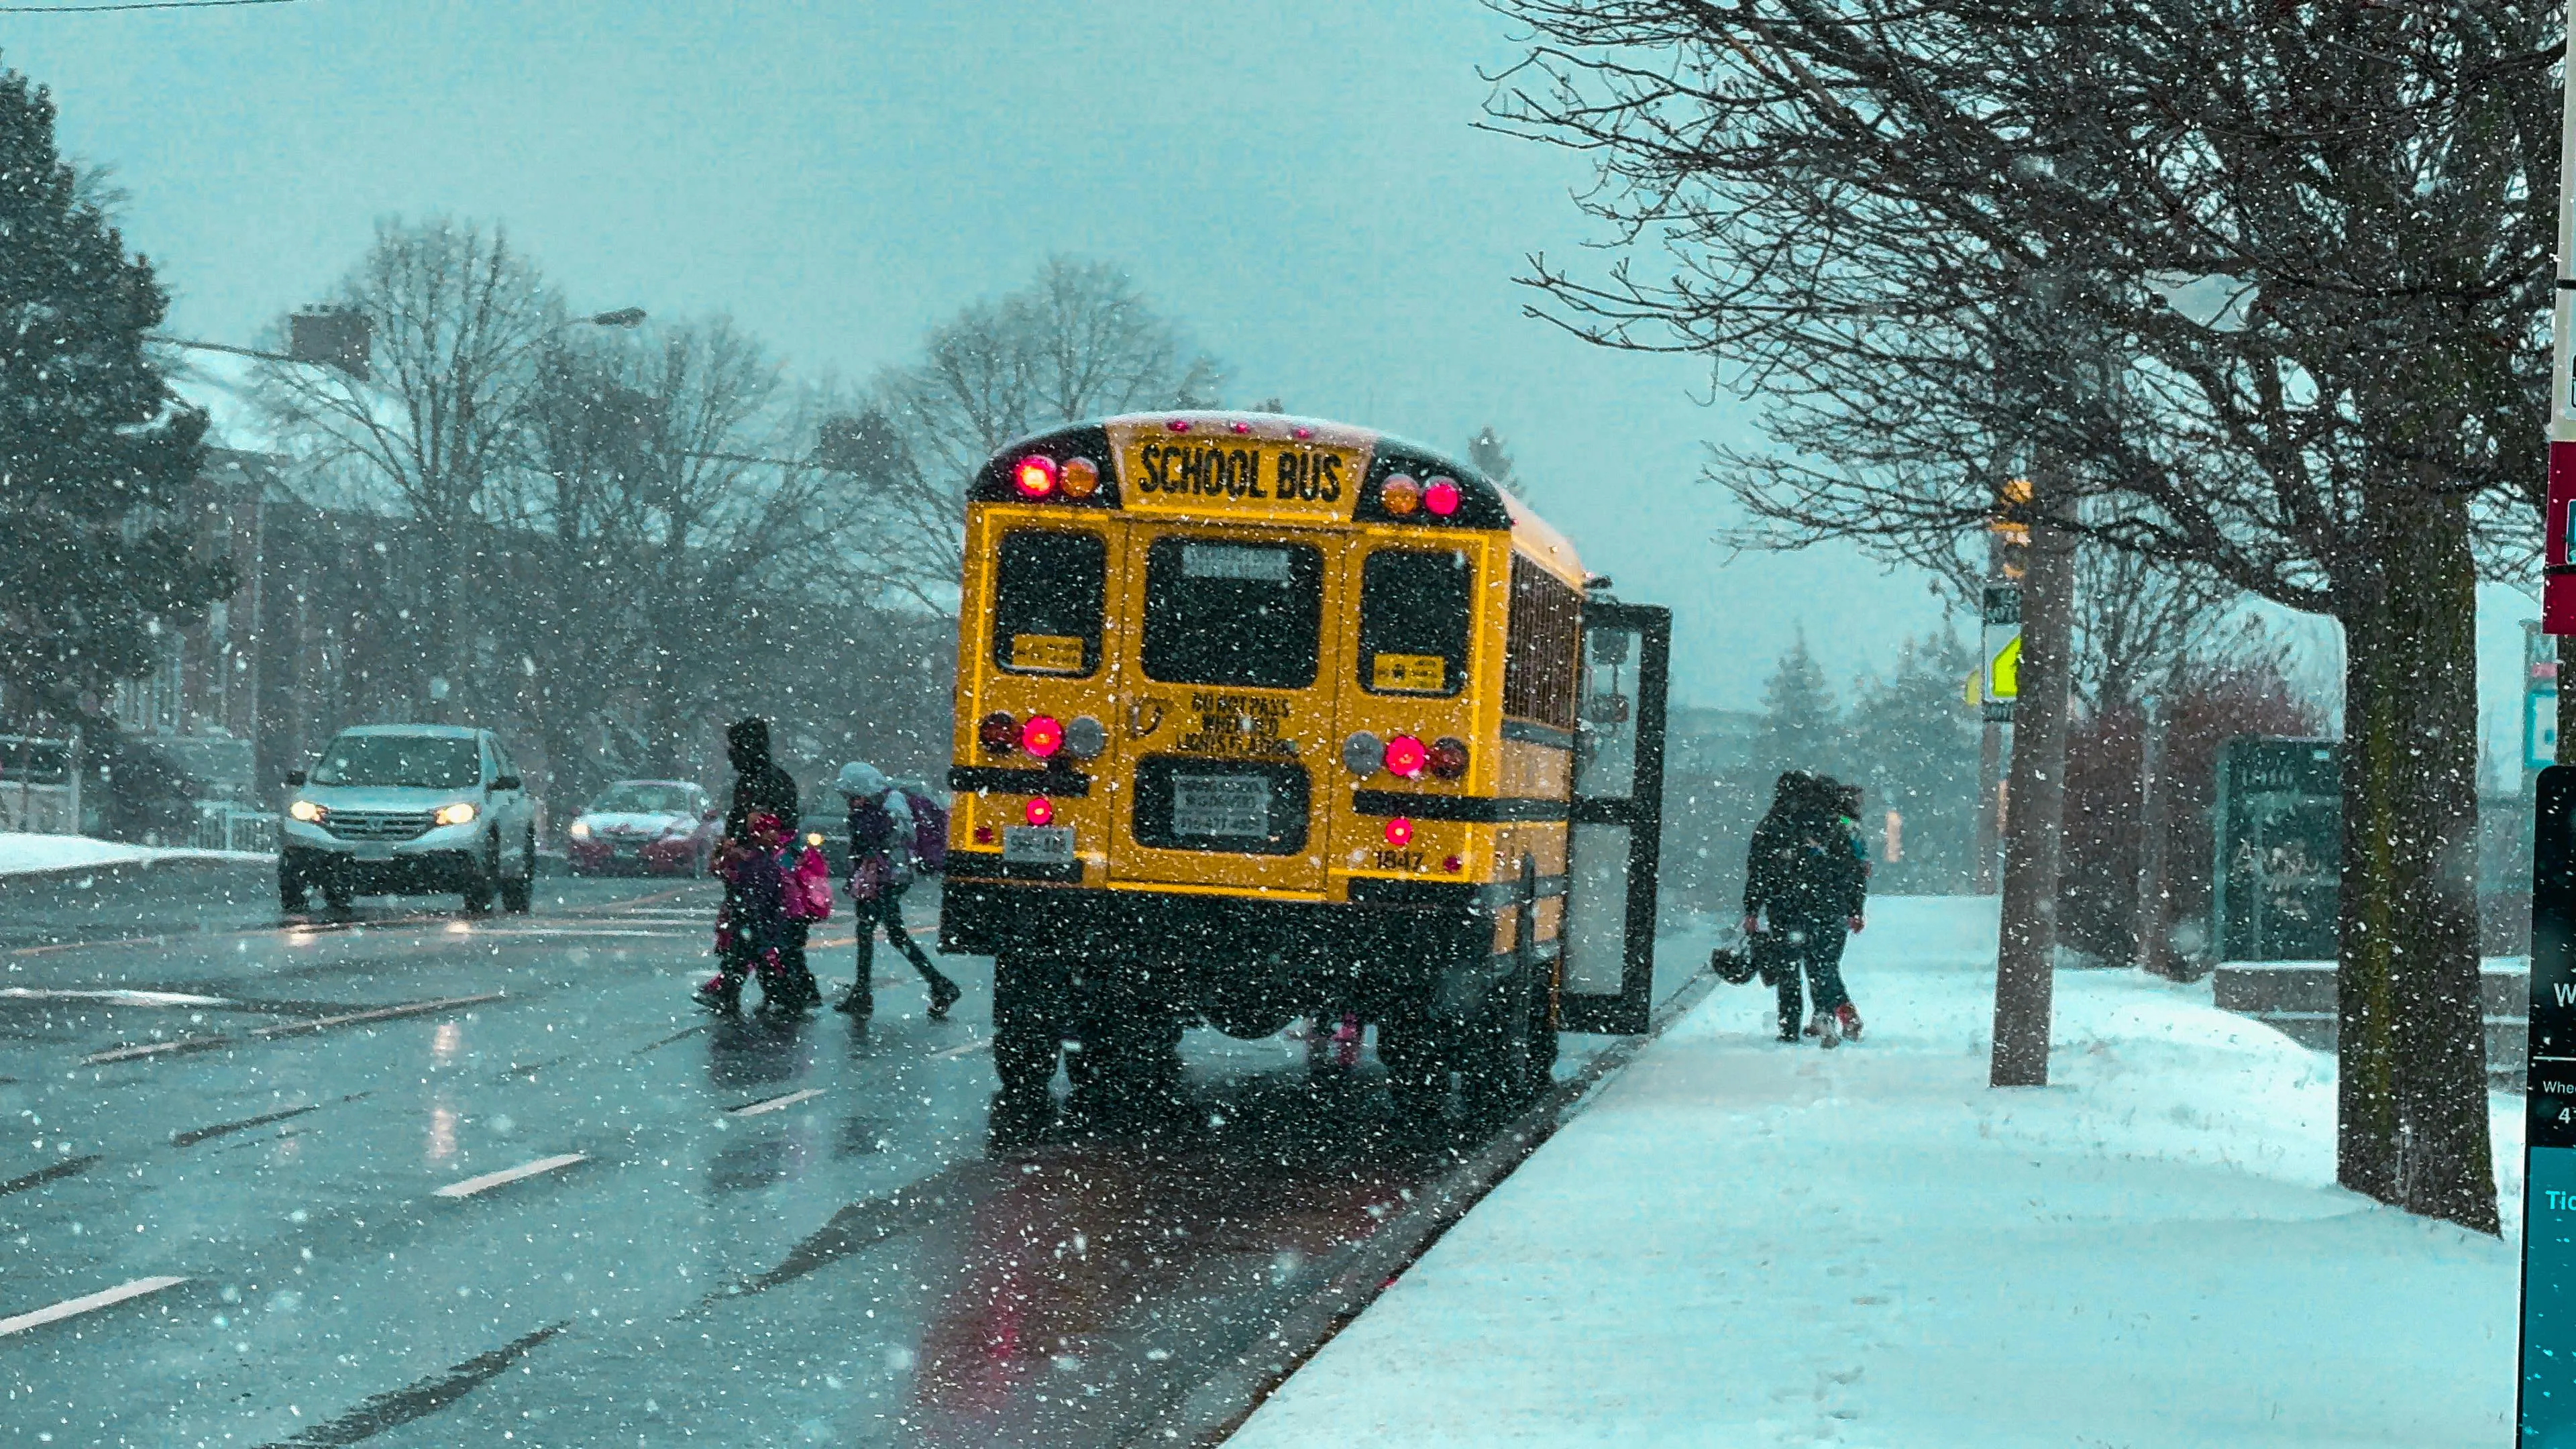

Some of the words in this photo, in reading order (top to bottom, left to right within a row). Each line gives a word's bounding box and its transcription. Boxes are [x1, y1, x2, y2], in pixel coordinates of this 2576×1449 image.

[1138, 443, 1268, 498] SCHOOL
[1276, 450, 1342, 502] BUS
[1191, 692, 1214, 712] DO
[1218, 694, 1246, 715] NOT
[1250, 696, 1289, 718] PASS
[1377, 849, 1424, 871] 1847
[2543, 1080, 2576, 1093] Whe
[2559, 1107, 2576, 1124] 4
